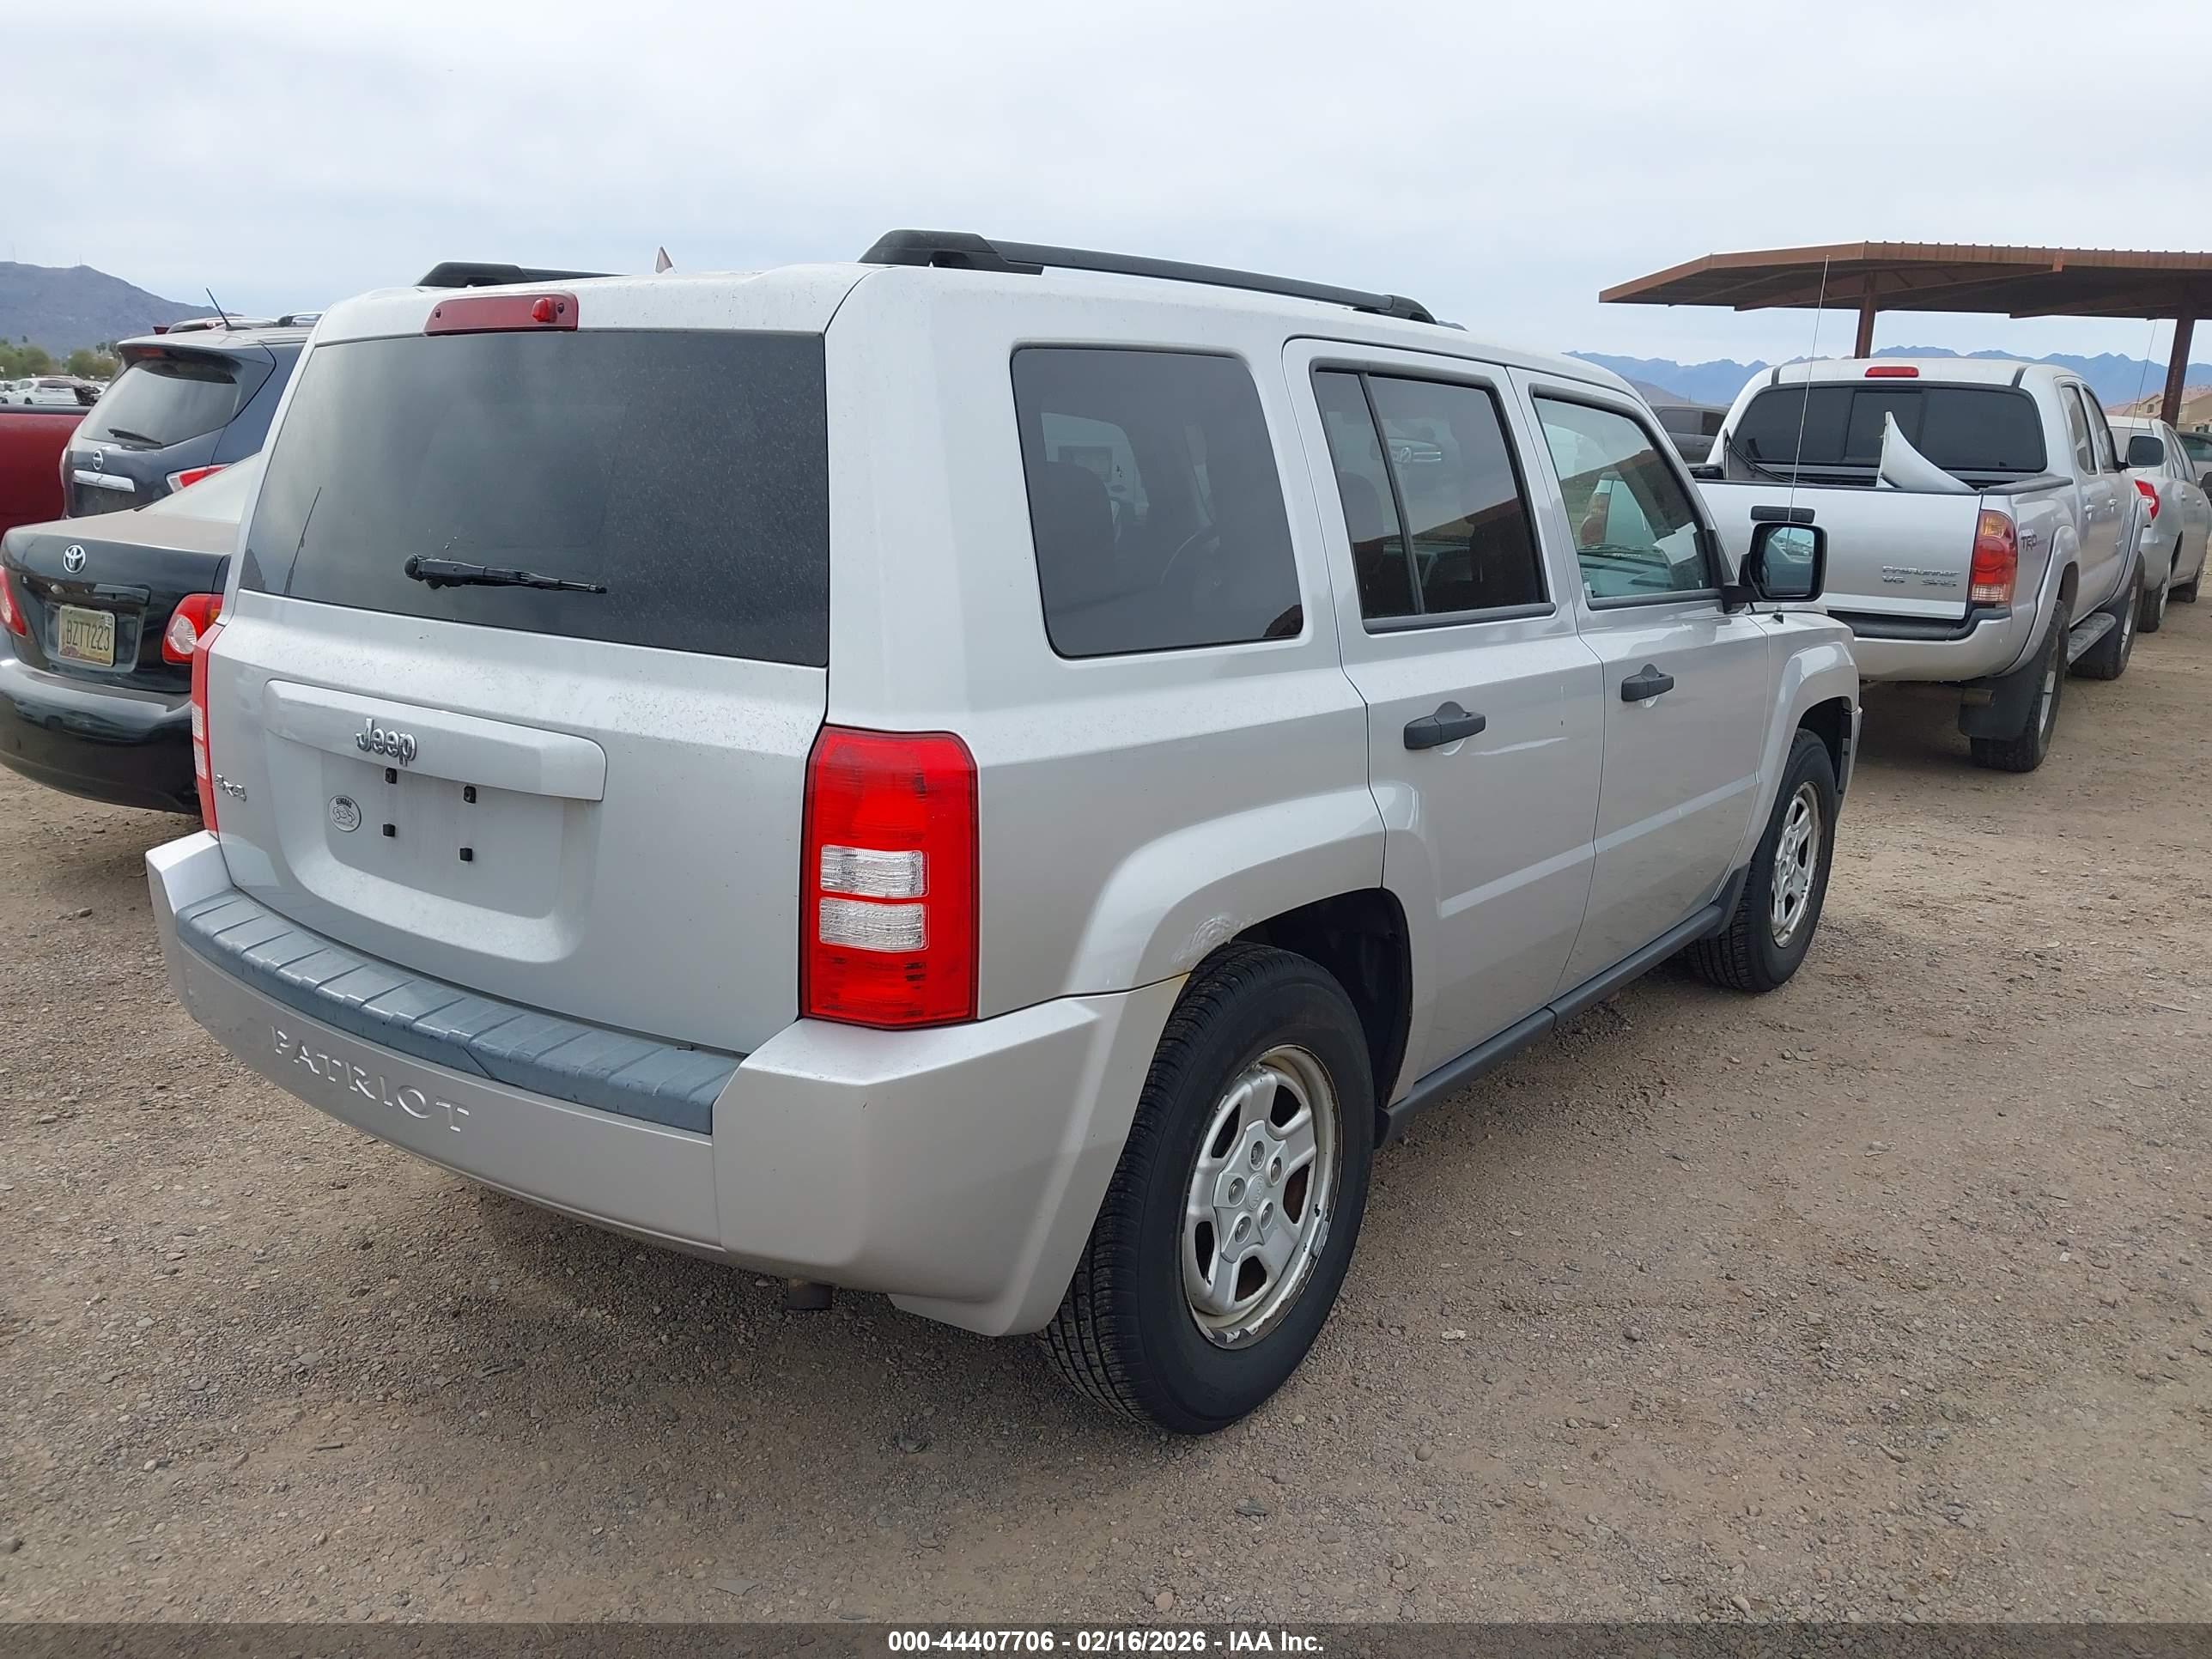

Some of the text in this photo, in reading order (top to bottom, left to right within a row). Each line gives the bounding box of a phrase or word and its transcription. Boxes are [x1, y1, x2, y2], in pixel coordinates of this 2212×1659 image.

[2021, 534, 2038, 552] TRD
[65, 618, 111, 652] BZT7223
[356, 716, 416, 767] Jeep
[270, 1026, 470, 1133] PATRIOT
